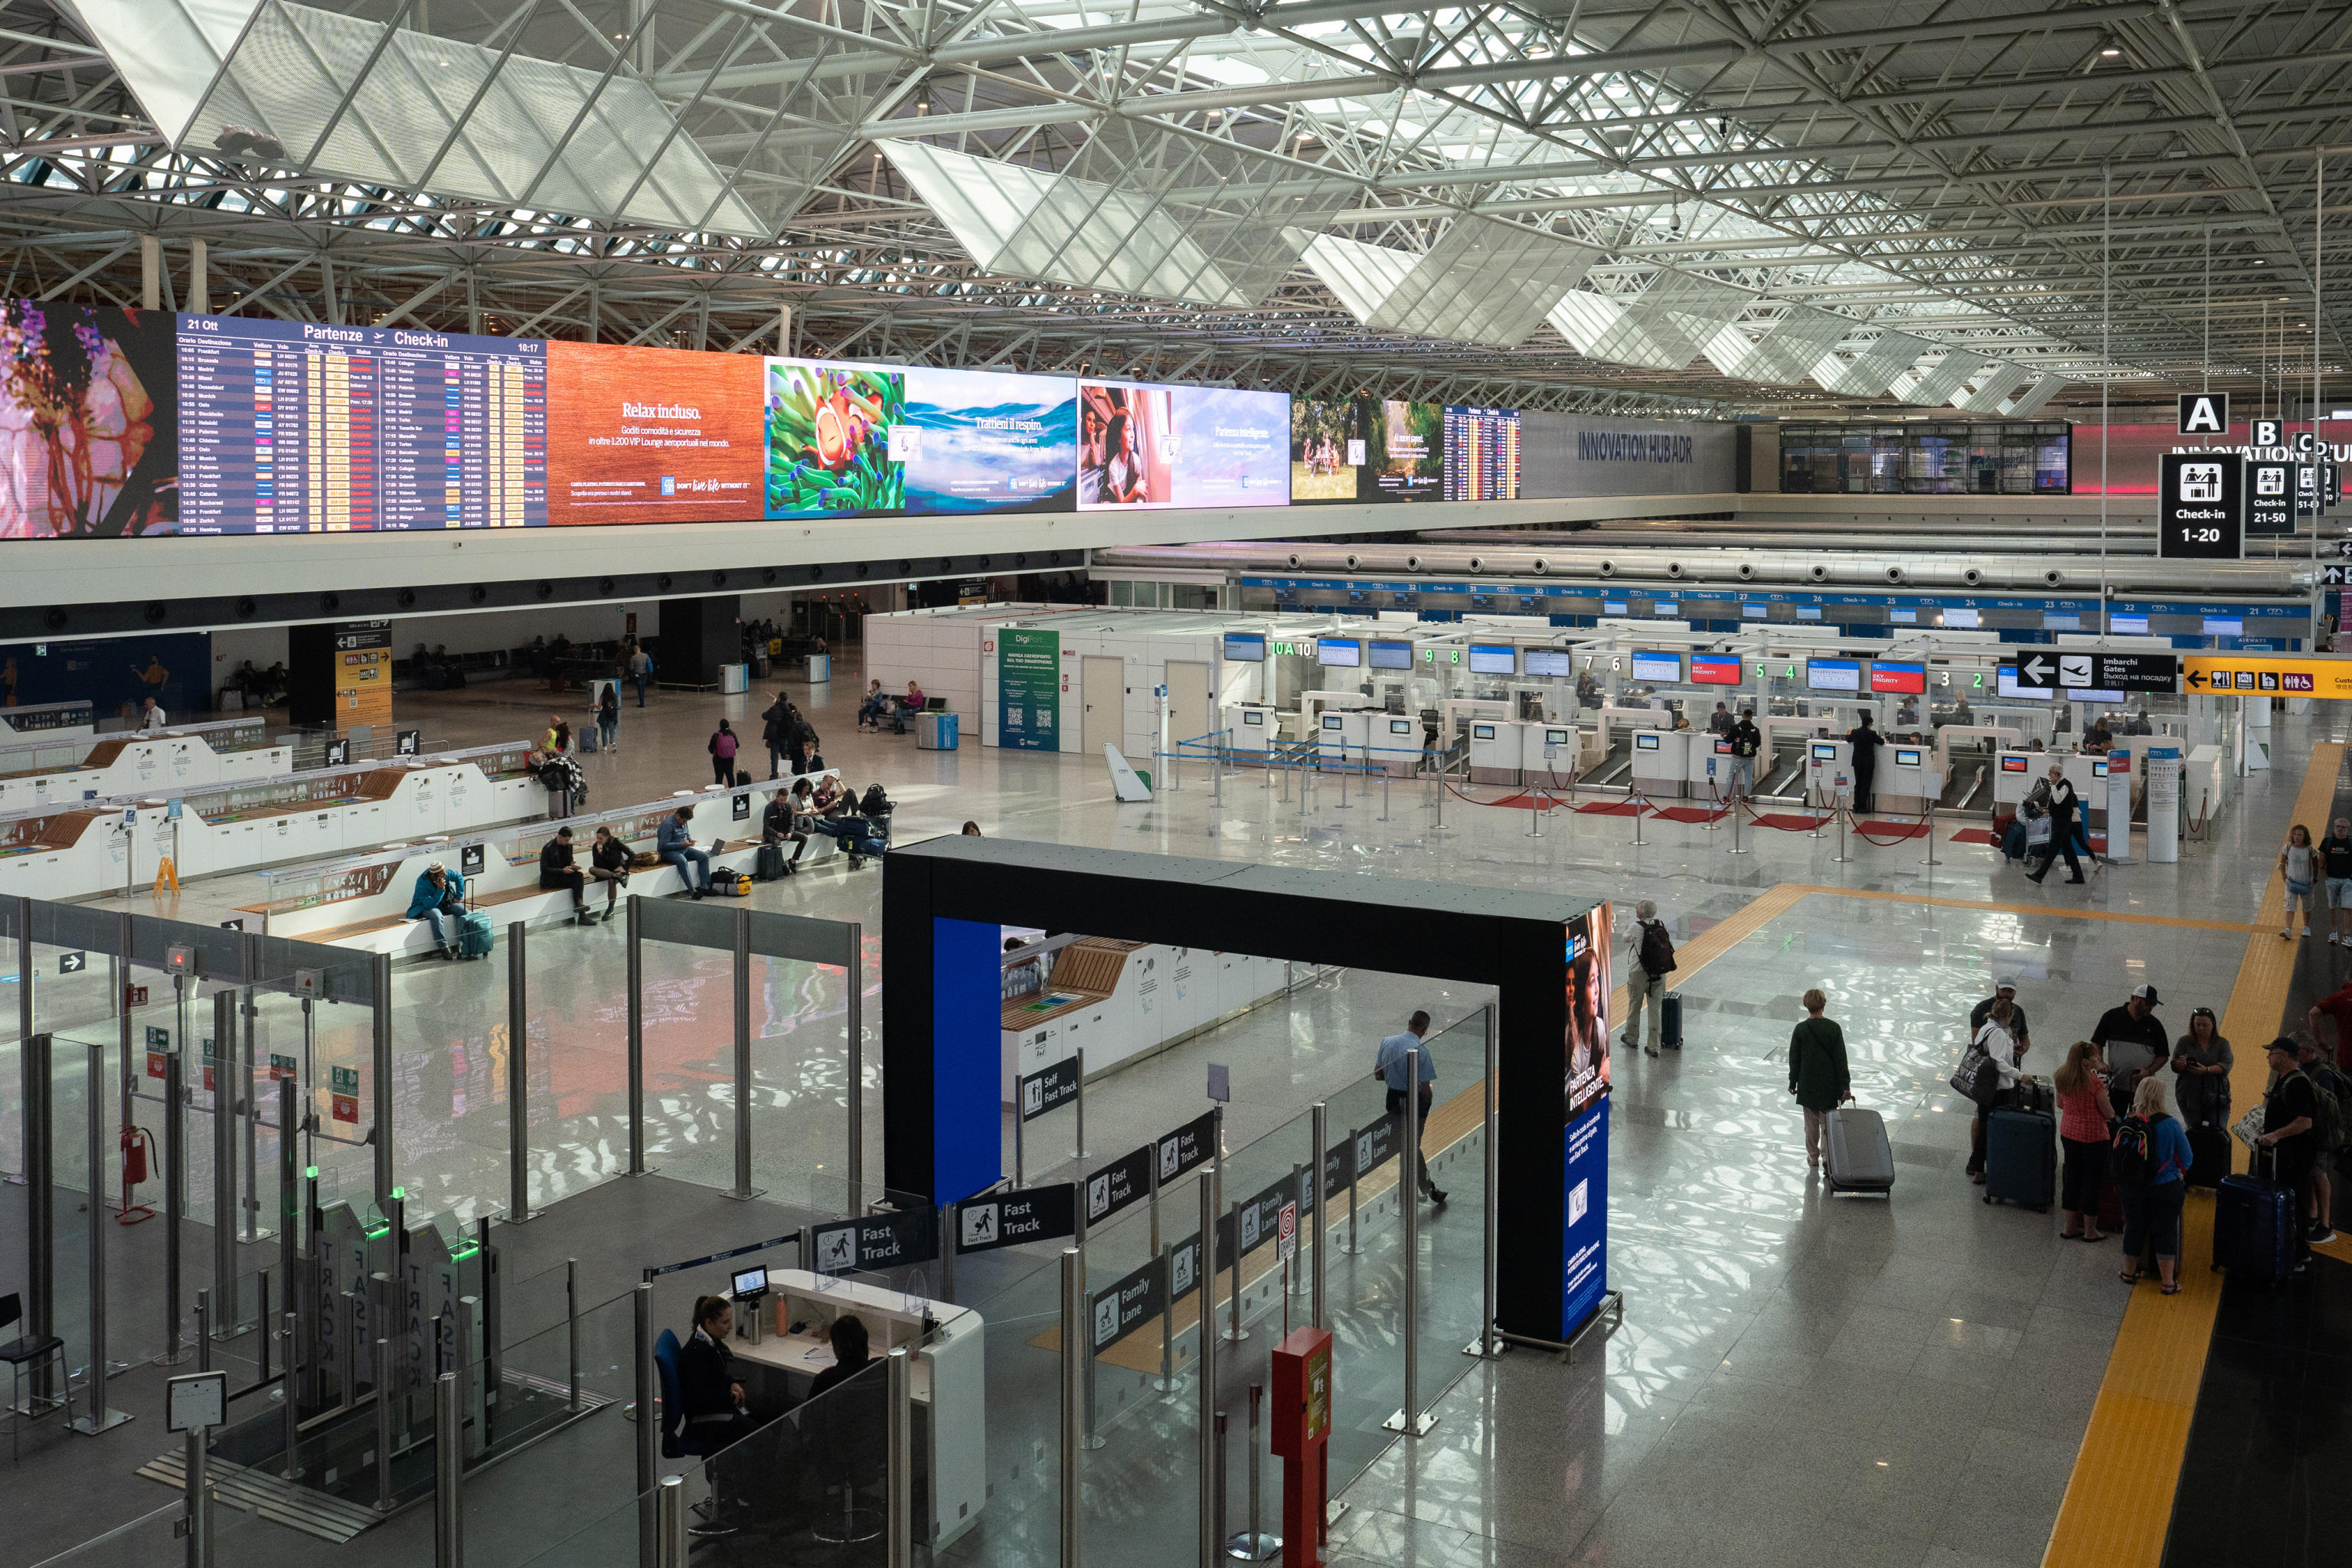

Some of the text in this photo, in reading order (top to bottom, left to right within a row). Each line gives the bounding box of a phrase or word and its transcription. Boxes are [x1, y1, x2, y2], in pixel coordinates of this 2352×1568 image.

[188, 319, 218, 331] 21 Ott
[198, 338, 232, 346] Destinazione
[304, 325, 448, 348] Partenze Check-in
[518, 343, 538, 352] 10:17
[622, 402, 701, 420] Relax incluso.
[2186, 397, 2220, 431] A
[621, 426, 640, 434] Goditi
[641, 426, 669, 436] comodità
[975, 416, 1043, 433] Trattieni il respiro.
[589, 436, 595, 445] in
[596, 437, 611, 446] oltre
[642, 439, 663, 448] Lounge
[664, 439, 698, 448] aeroportuali
[2258, 422, 2276, 446] B
[1579, 431, 1693, 463] INNOVATION HUB ADR
[2299, 434, 2312, 452] C
[2318, 442, 2328, 456] D
[693, 479, 707, 492] live
[707, 478, 720, 493] life
[2176, 509, 2226, 519] Check-in
[2254, 512, 2285, 523] 21-50
[2182, 528, 2220, 542] 1-20
[1298, 644, 1311, 656] 10
[1426, 649, 1433, 662] 9
[1451, 651, 1459, 663] 8
[1585, 656, 1593, 670] 7
[1612, 658, 1620, 671] 6
[1756, 664, 1764, 678] 5
[1785, 665, 1795, 679] 4
[1942, 671, 1949, 685] 3
[2103, 672, 2128, 681] Выход
[2141, 675, 2171, 683] посадку
[1973, 673, 1982, 688] 2
[1044, 1073, 1058, 1088] Self
[1570, 1064, 1596, 1094] PARTENZA
[1045, 1081, 1077, 1102] Fast Track
[1570, 1075, 1604, 1112] INTELLIGENTE
[1181, 1132, 1194, 1148] Fast
[1374, 1122, 1392, 1142] Family
[1181, 1147, 1199, 1165] Track
[1374, 1142, 1387, 1158] Lane
[1326, 1155, 1340, 1171] mily
[1112, 1169, 1127, 1186] Fast
[1112, 1184, 1132, 1203] Track
[1004, 1201, 1031, 1217] Fast
[1262, 1191, 1283, 1214] Family
[1004, 1218, 1040, 1235] Track
[1262, 1214, 1277, 1232] Lane
[863, 1226, 891, 1241] Fast
[862, 1243, 901, 1260] Track
[1122, 1278, 1149, 1305] Family
[1122, 1304, 1142, 1325] Lane
